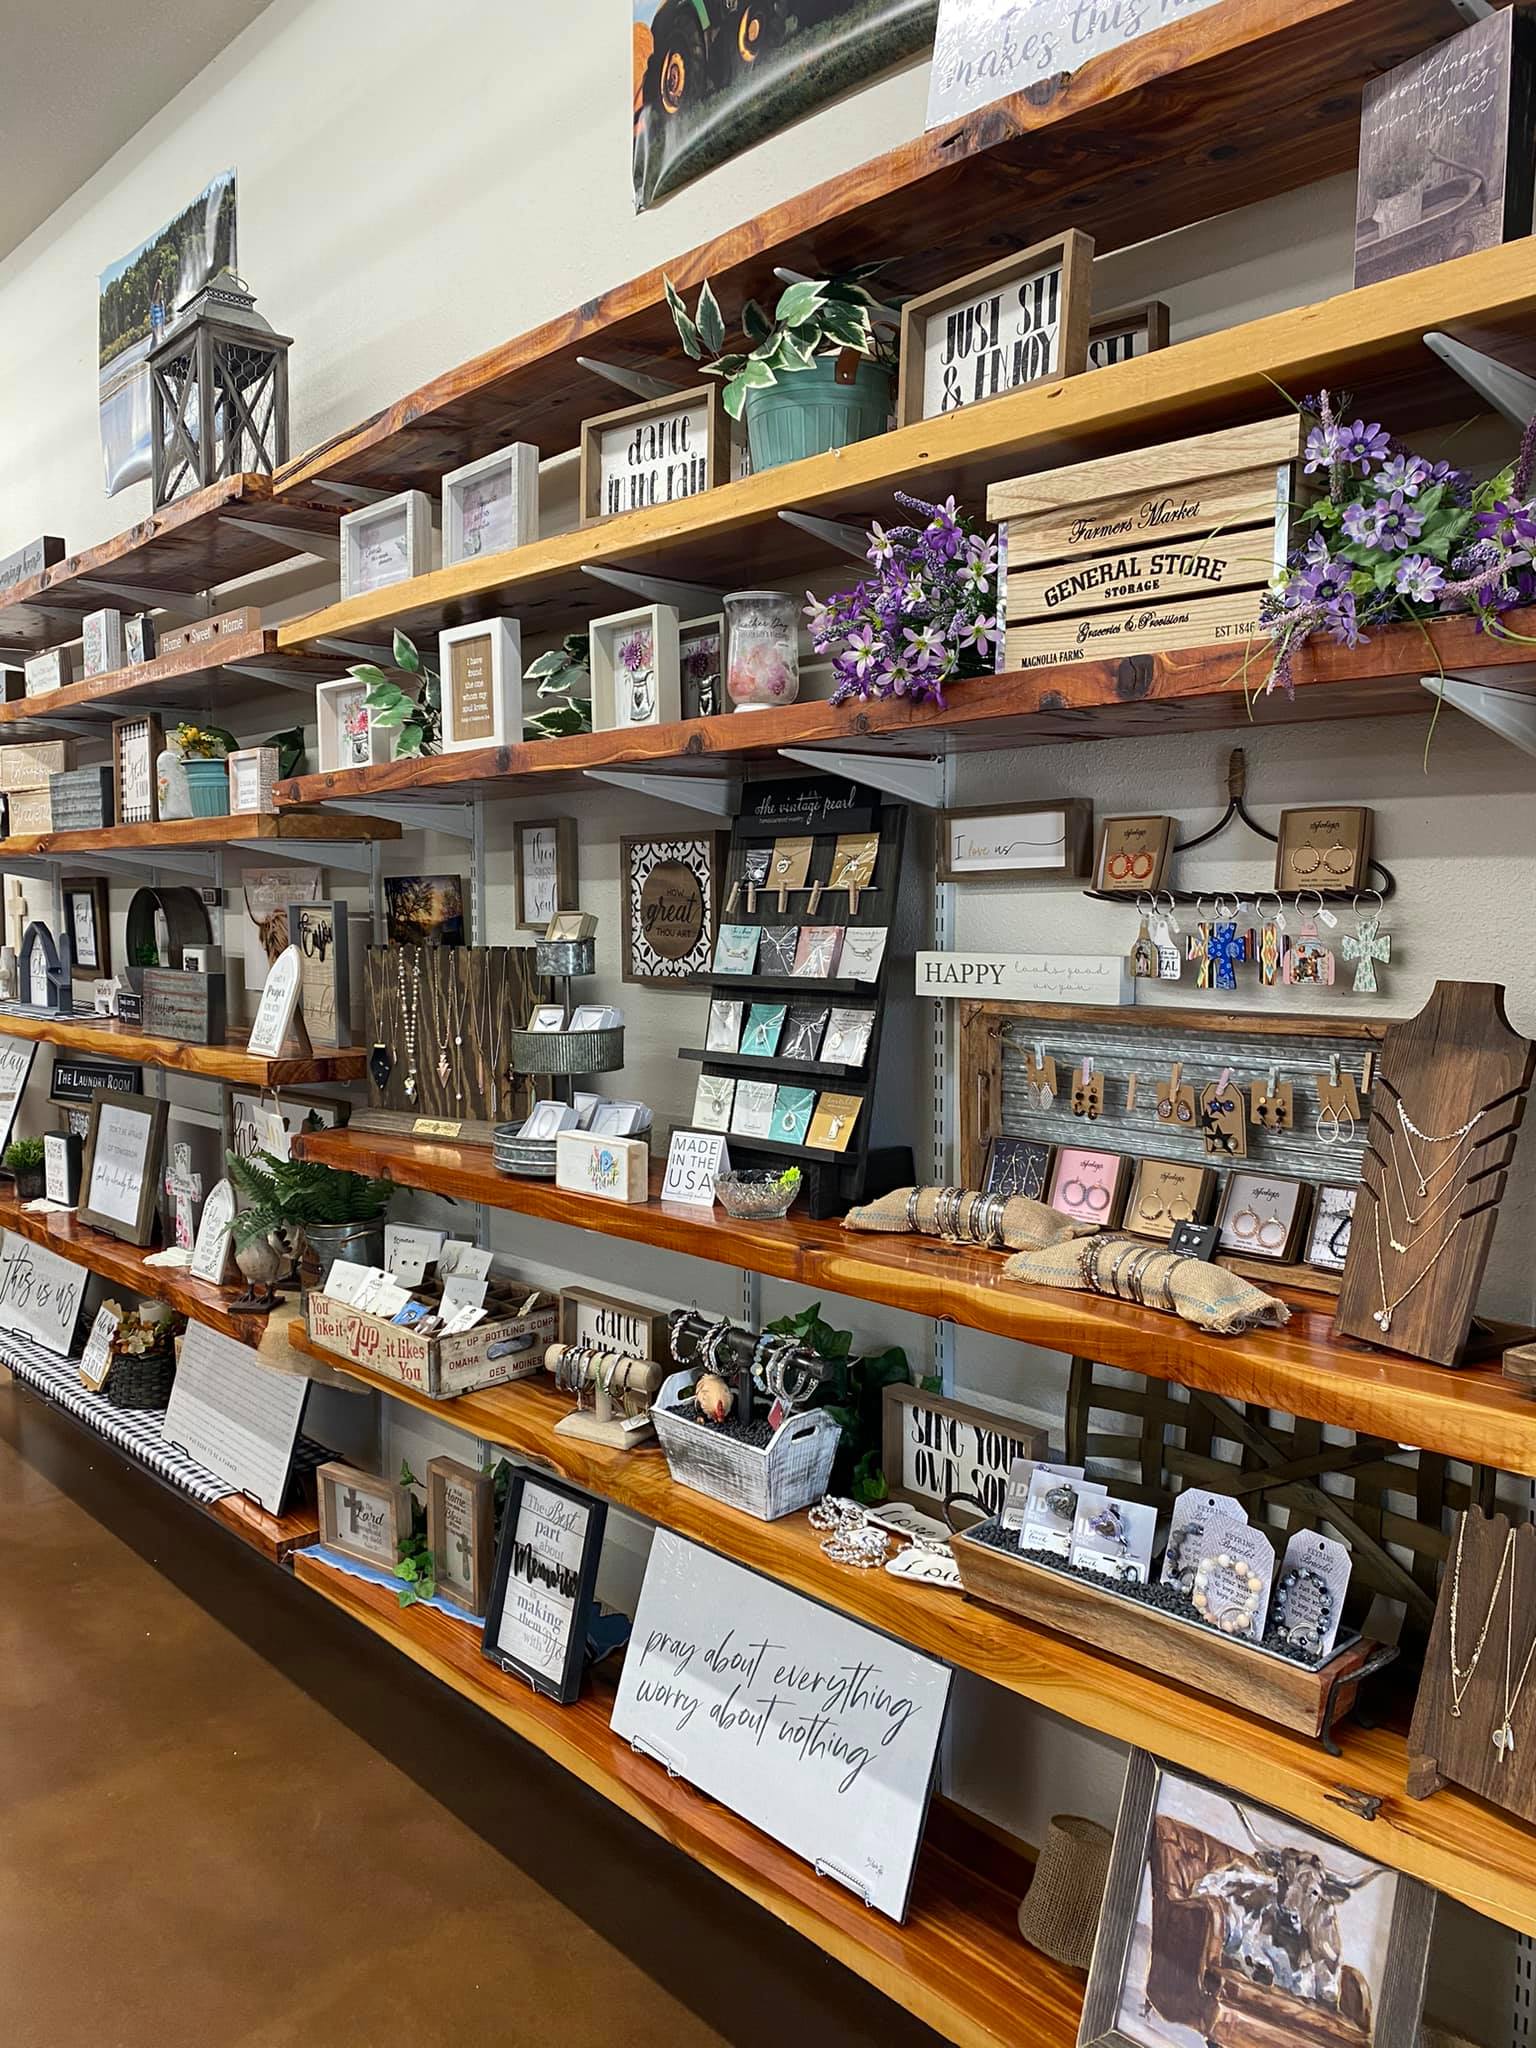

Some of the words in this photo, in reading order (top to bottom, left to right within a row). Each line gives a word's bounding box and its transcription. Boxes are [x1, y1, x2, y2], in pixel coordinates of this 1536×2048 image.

[941, 293, 1004, 366] JUST
[1017, 268, 1063, 336] SIT
[975, 326, 1057, 401] ENJOY
[628, 416, 691, 466] dance
[608, 474, 625, 514] in
[631, 470, 659, 509] the
[1069, 517, 1133, 544] Farmers
[1137, 498, 1201, 528] Market
[1044, 557, 1141, 607] GENERAL
[1150, 554, 1228, 582] STORE
[1104, 579, 1160, 598] STORAGE
[1124, 616, 1137, 632] &
[1138, 611, 1190, 630] Provisions
[1215, 626, 1232, 638] EST
[1234, 621, 1256, 635] 1846
[162, 637, 181, 652] Home
[191, 627, 210, 644] Sweet
[223, 618, 243, 634] Home
[470, 656, 483, 666] have
[1021, 653, 1057, 668] MAGNOLIA
[1059, 648, 1085, 664] FARMS
[756, 794, 776, 816] the
[779, 794, 822, 825] vintage
[823, 785, 857, 820] pearl
[954, 834, 966, 860] I
[968, 840, 990, 856] love
[667, 889, 684, 897] HOW
[644, 892, 697, 932] great
[656, 928, 675, 937] THOU
[677, 930, 691, 938] ART
[925, 962, 1006, 985] HAPPY
[1015, 961, 1064, 975] looks
[1066, 966, 1110, 978] good
[1058, 984, 1092, 996] you
[675, 1138, 718, 1155] MADE
[672, 1153, 685, 1166] IN
[691, 1156, 715, 1170] THE
[669, 1168, 712, 1192] USA
[36, 1279, 51, 1308] is
[55, 1282, 77, 1328] us
[311, 1295, 329, 1315] You
[315, 1318, 334, 1336] like
[335, 1319, 343, 1336] it
[397, 1338, 425, 1360] likes
[455, 1341, 461, 1350] 7
[467, 1337, 479, 1347] UP
[485, 1324, 525, 1342] BOTTLING
[531, 1316, 557, 1330] COMP
[398, 1361, 422, 1381] You
[449, 1356, 480, 1370] OMAHA
[489, 1366, 506, 1378] DES
[512, 1356, 543, 1371] MOINES
[911, 1406, 964, 1458] SING
[915, 1448, 959, 1498] OWN
[1009, 1481, 1028, 1497] ID
[527, 1493, 545, 1514] The
[540, 1500, 581, 1532] Best
[1029, 1495, 1049, 1513] ID
[355, 1507, 385, 1527] Lord
[873, 1510, 936, 1537] Love
[535, 1520, 561, 1544] part
[1225, 1532, 1257, 1550] KEYRING
[539, 1540, 564, 1563] about
[1218, 1540, 1256, 1560] Bracelet
[1308, 1546, 1334, 1564] KEYRING
[1300, 1552, 1334, 1573] Bracelet
[517, 1594, 564, 1634] making
[519, 1612, 542, 1632] them
[523, 1632, 542, 1650] with
[542, 1627, 563, 1667] Yo
[639, 1629, 701, 1677] pray
[704, 1629, 786, 1688] about
[774, 1662, 923, 1745] everything
[635, 1678, 705, 1731] worry
[709, 1684, 796, 1746] about
[778, 1716, 879, 1794] nothing
